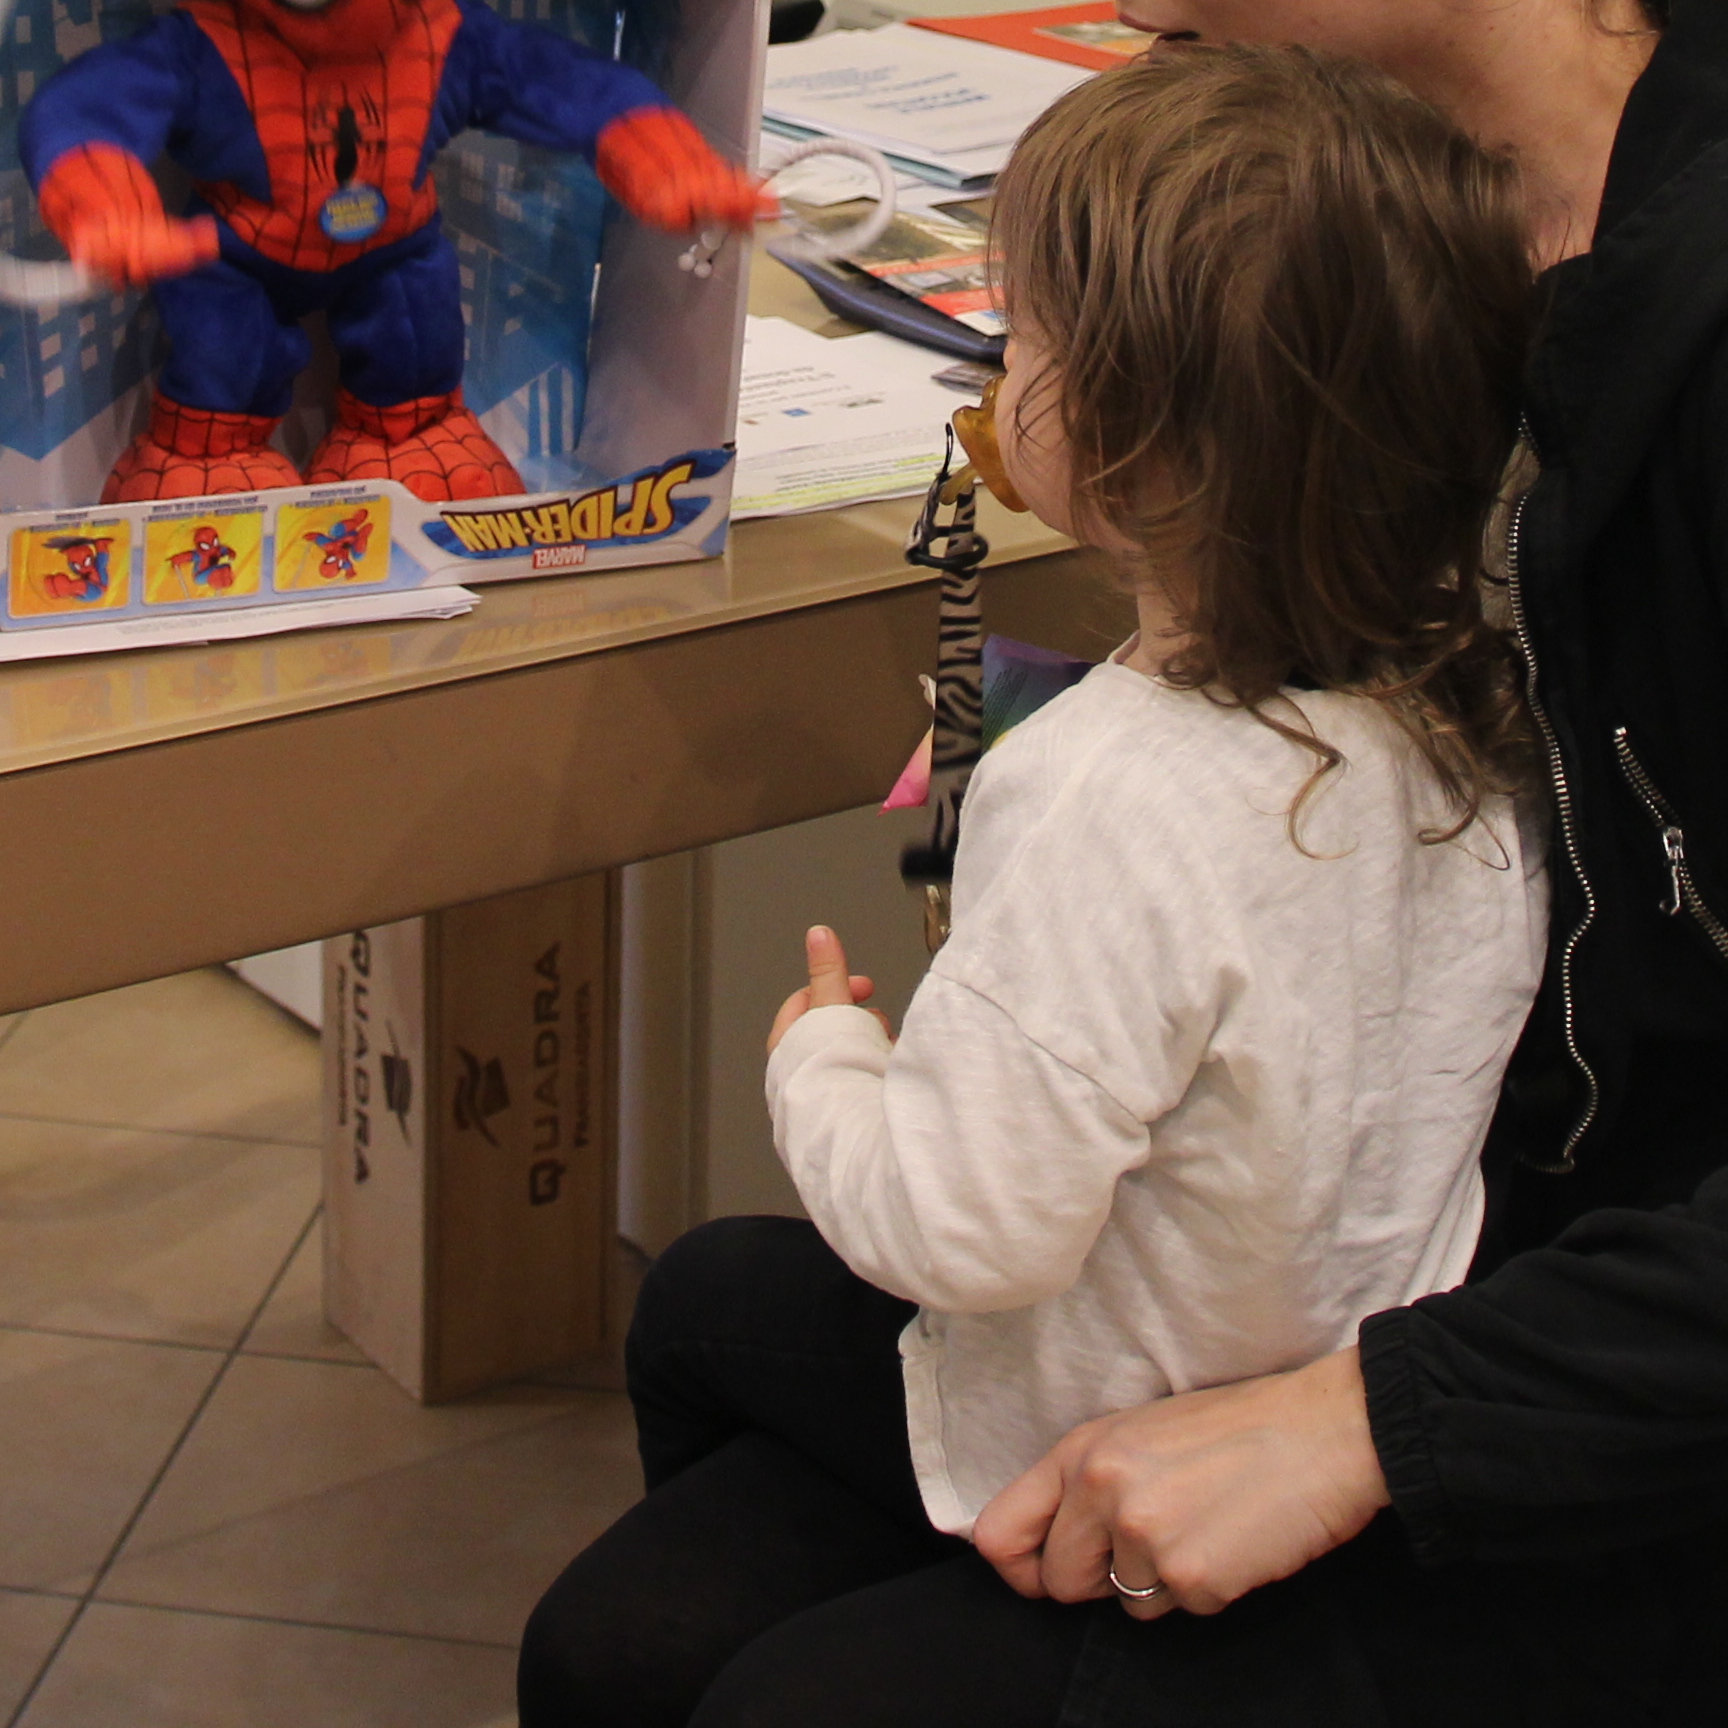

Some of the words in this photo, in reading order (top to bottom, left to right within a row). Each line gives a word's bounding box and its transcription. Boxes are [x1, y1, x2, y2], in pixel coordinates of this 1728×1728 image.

[440, 461, 695, 550] SPIDER-MAN
[532, 545, 586, 569] MARVEL
[351, 931, 372, 1184] QUADRA
[528, 940, 567, 1206] QUADRA
